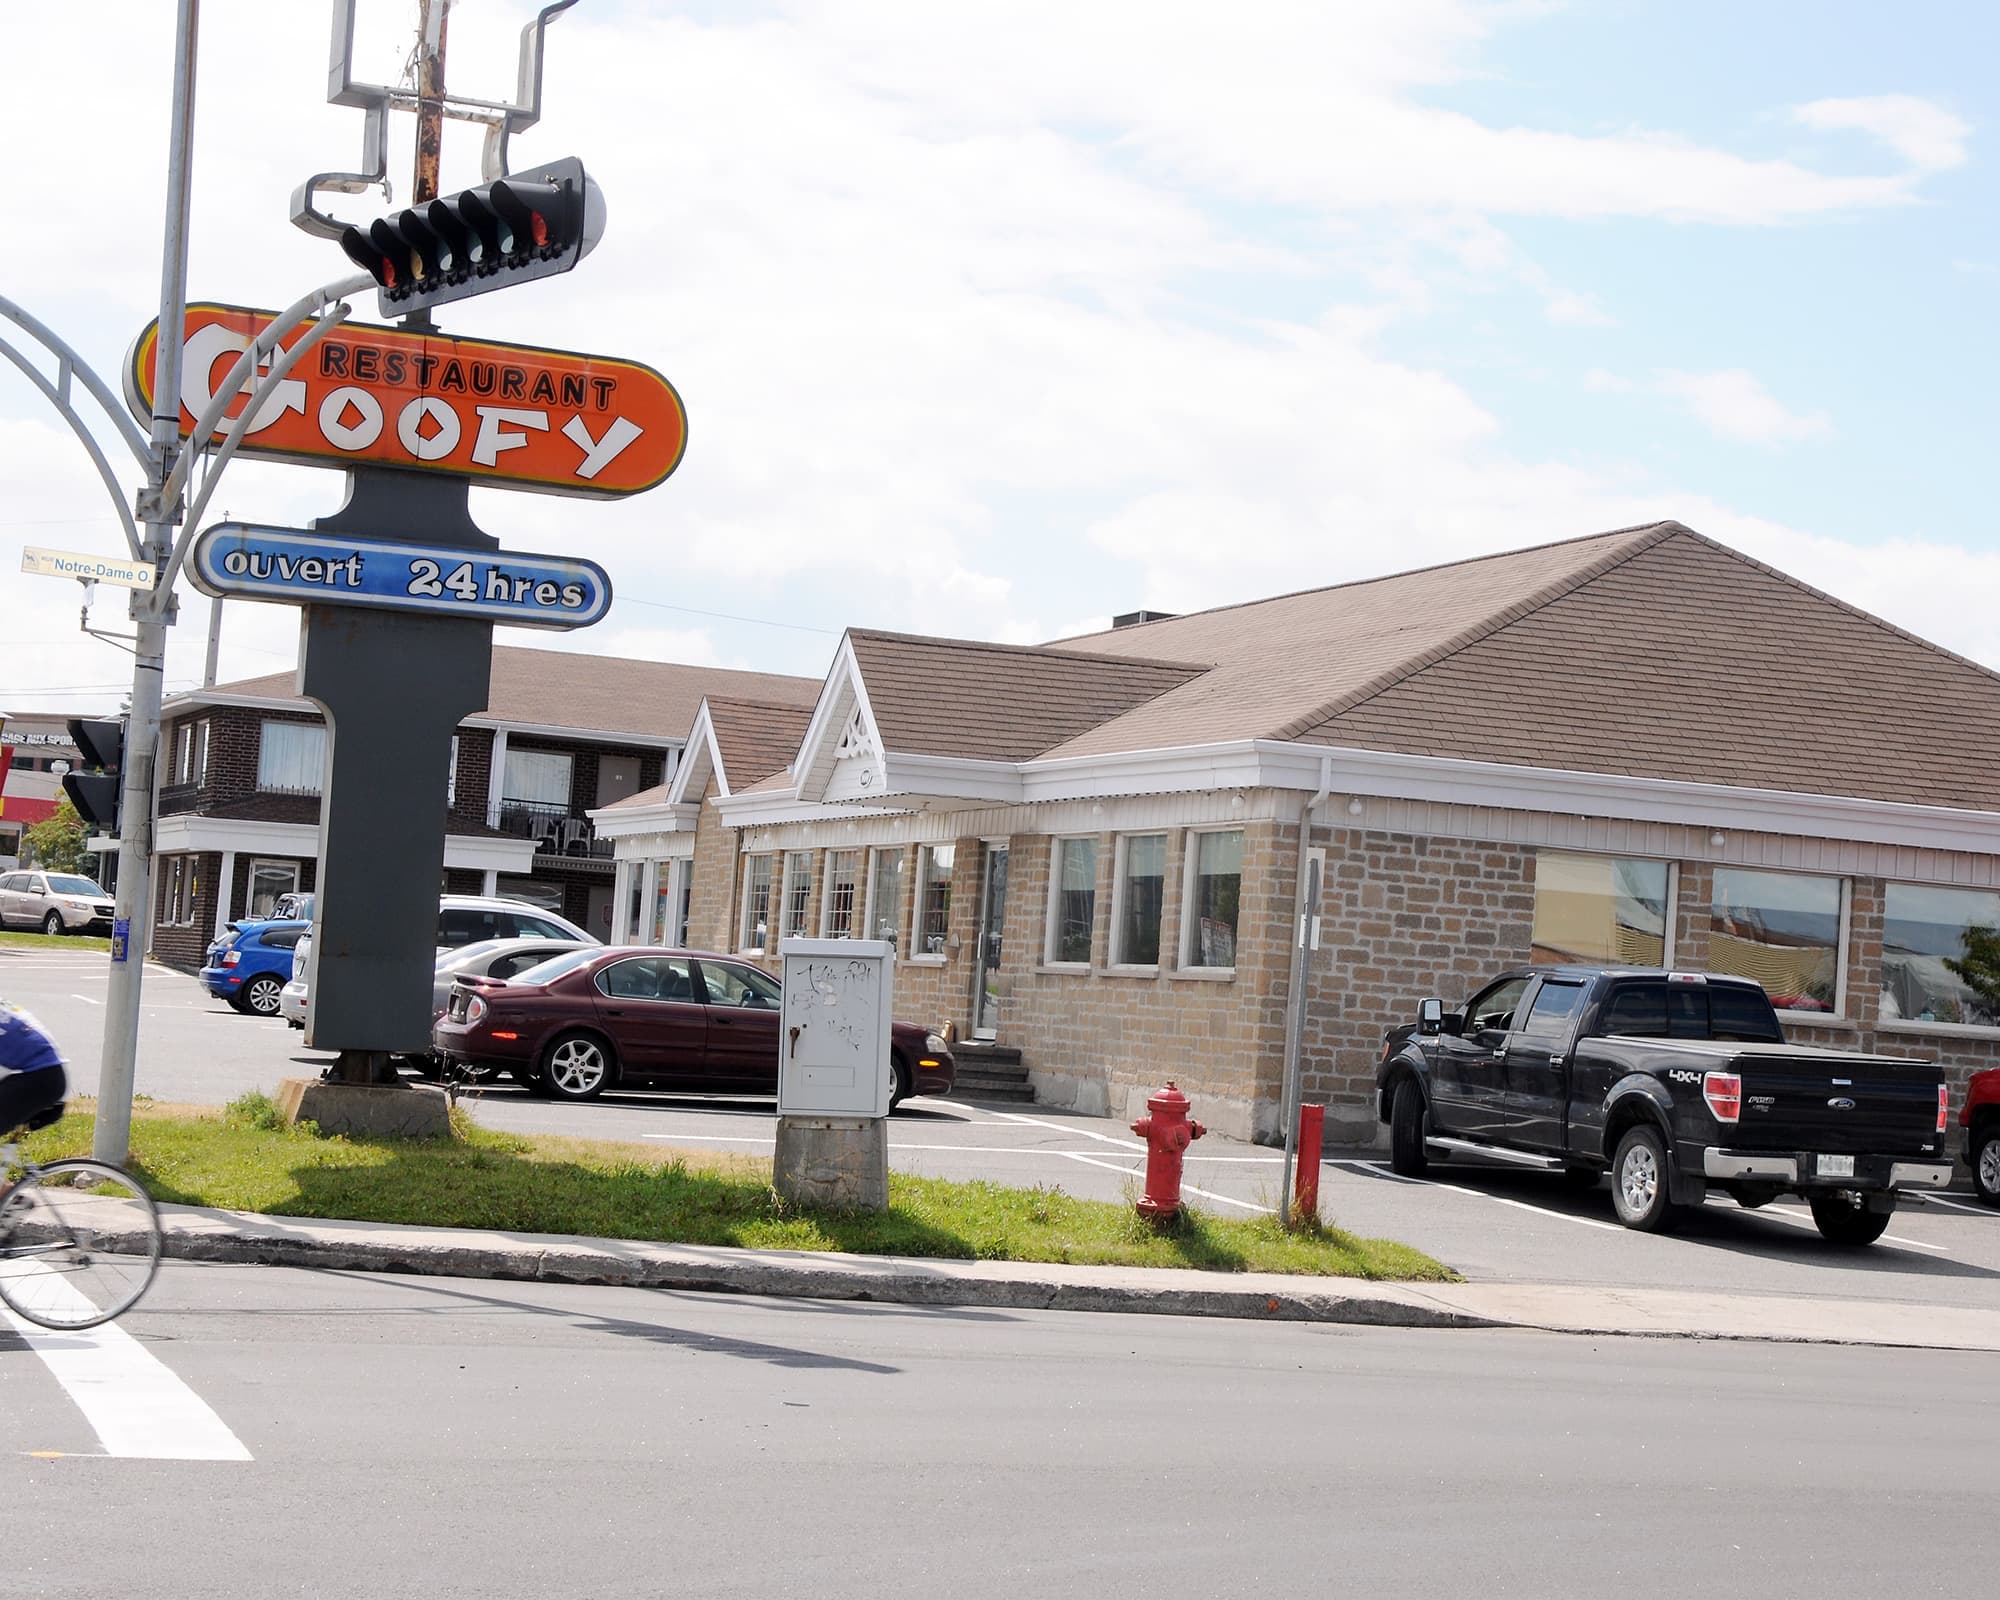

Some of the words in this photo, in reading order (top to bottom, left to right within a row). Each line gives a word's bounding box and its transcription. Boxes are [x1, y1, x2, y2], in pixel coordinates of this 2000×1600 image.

[320, 342, 617, 412] RESTAURANT
[180, 321, 645, 480] GOOFY
[54, 557, 134, 580] Notre-Dame
[137, 570, 152, 583] O.
[224, 550, 365, 588] ouvert
[1, 731, 26, 744] CAGE
[26, 733, 47, 745] AUX
[47, 734, 77, 746] SPOR
